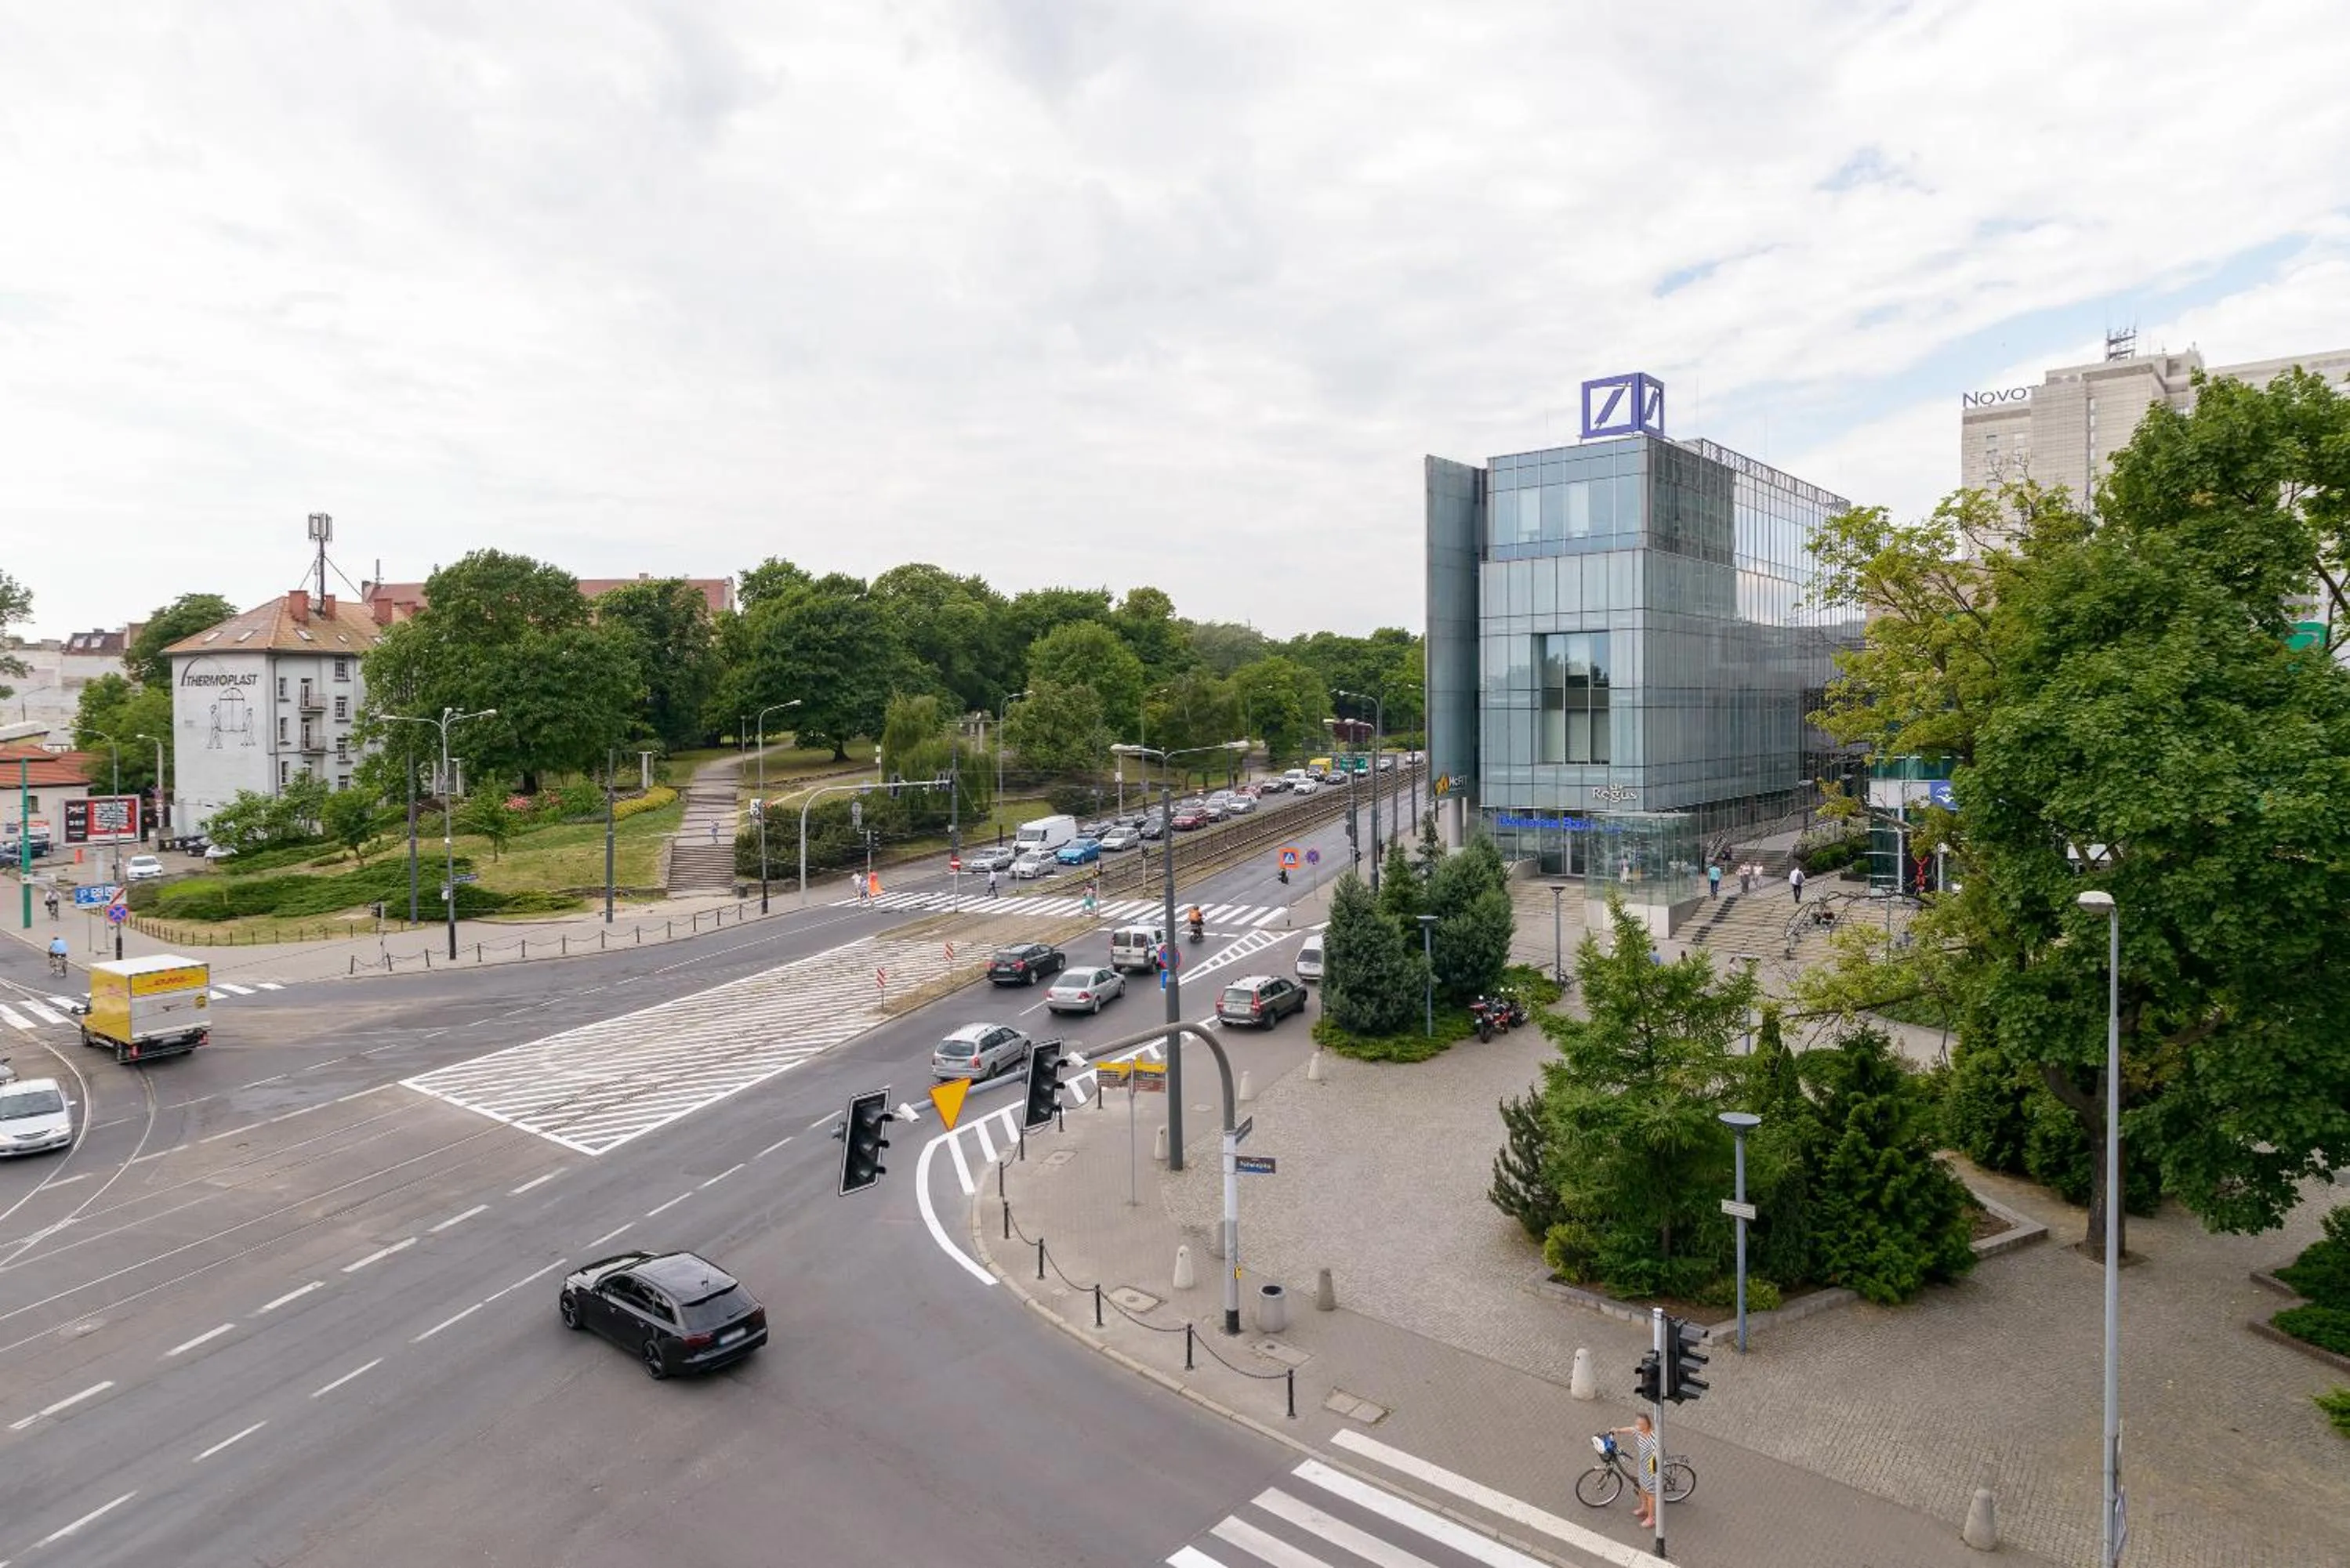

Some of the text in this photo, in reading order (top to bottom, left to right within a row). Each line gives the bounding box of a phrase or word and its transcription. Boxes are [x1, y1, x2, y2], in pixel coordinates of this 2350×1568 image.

[1963, 385, 2040, 407] NOVO
[187, 675, 257, 686] THERMOPLAST
[1592, 787, 1637, 802] Regus
